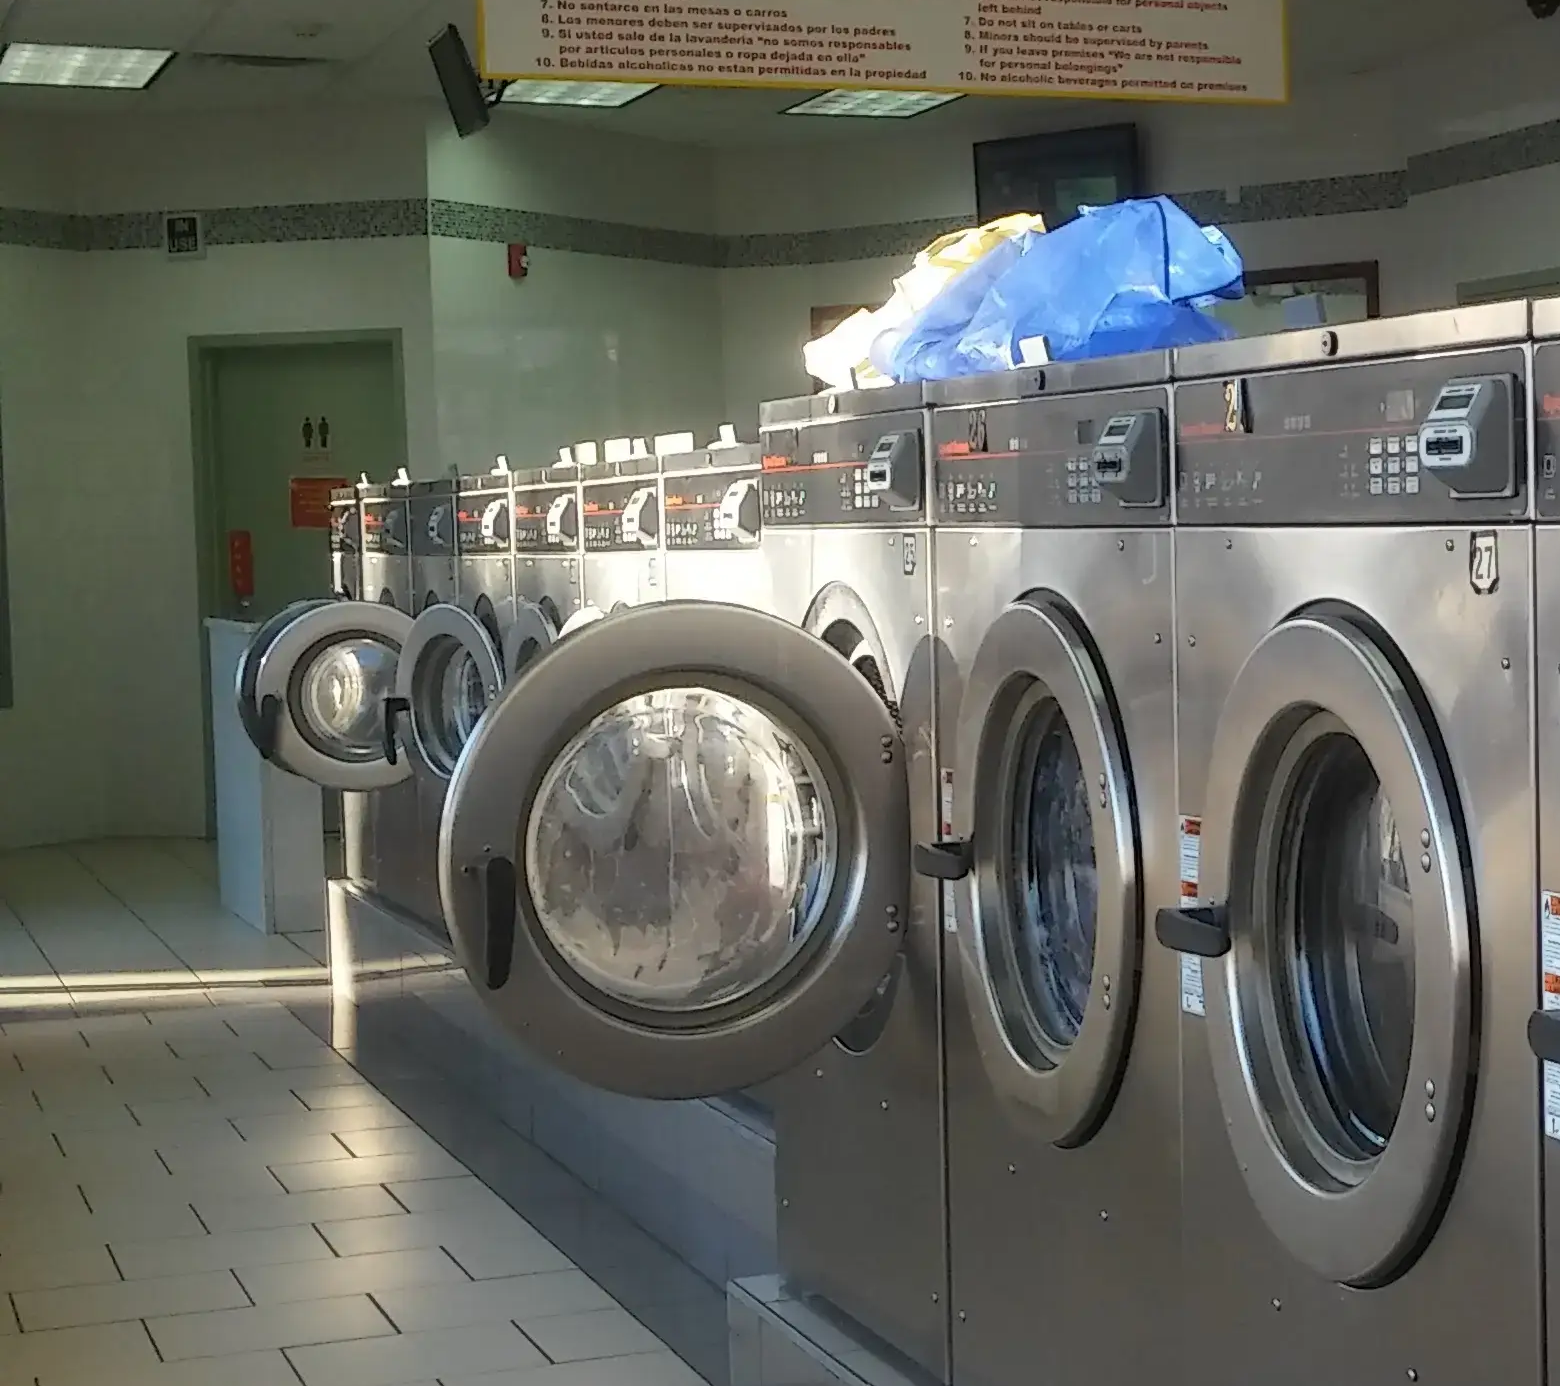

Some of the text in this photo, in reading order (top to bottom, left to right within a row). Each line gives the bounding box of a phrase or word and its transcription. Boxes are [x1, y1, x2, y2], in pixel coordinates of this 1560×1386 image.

[556, 0, 575, 10] No
[643, 4, 660, 13] en
[662, 3, 683, 14] las
[686, 6, 730, 16] mesas
[744, 8, 788, 18] carros
[557, 13, 581, 24] Los
[585, 16, 644, 27] menores
[647, 17, 688, 29] deben
[691, 21, 714, 30] ser
[805, 25, 827, 36] por
[830, 24, 849, 35] los
[852, 25, 896, 39] padres
[557, 28, 572, 39] Si
[575, 29, 613, 40] usted
[616, 30, 645, 41] sale
[648, 32, 665, 42] de
[668, 32, 681, 43] la
[756, 36, 779, 46] "no
[782, 38, 825, 48] somos
[827, 38, 911, 53] responsables
[558, 44, 581, 56] por
[648, 46, 722, 61] personales
[736, 51, 767, 62] ropa
[769, 50, 814, 64] dejada
[816, 54, 833, 62] en
[835, 53, 866, 63] ella"
[559, 57, 613, 69] Bebidas
[696, 64, 715, 72] no
[717, 63, 754, 74] estan
[757, 64, 827, 78] permitidas
[829, 68, 846, 77] en
[848, 67, 861, 77] la
[864, 68, 927, 81] propiedad
[1473, 545, 1493, 580] 27
